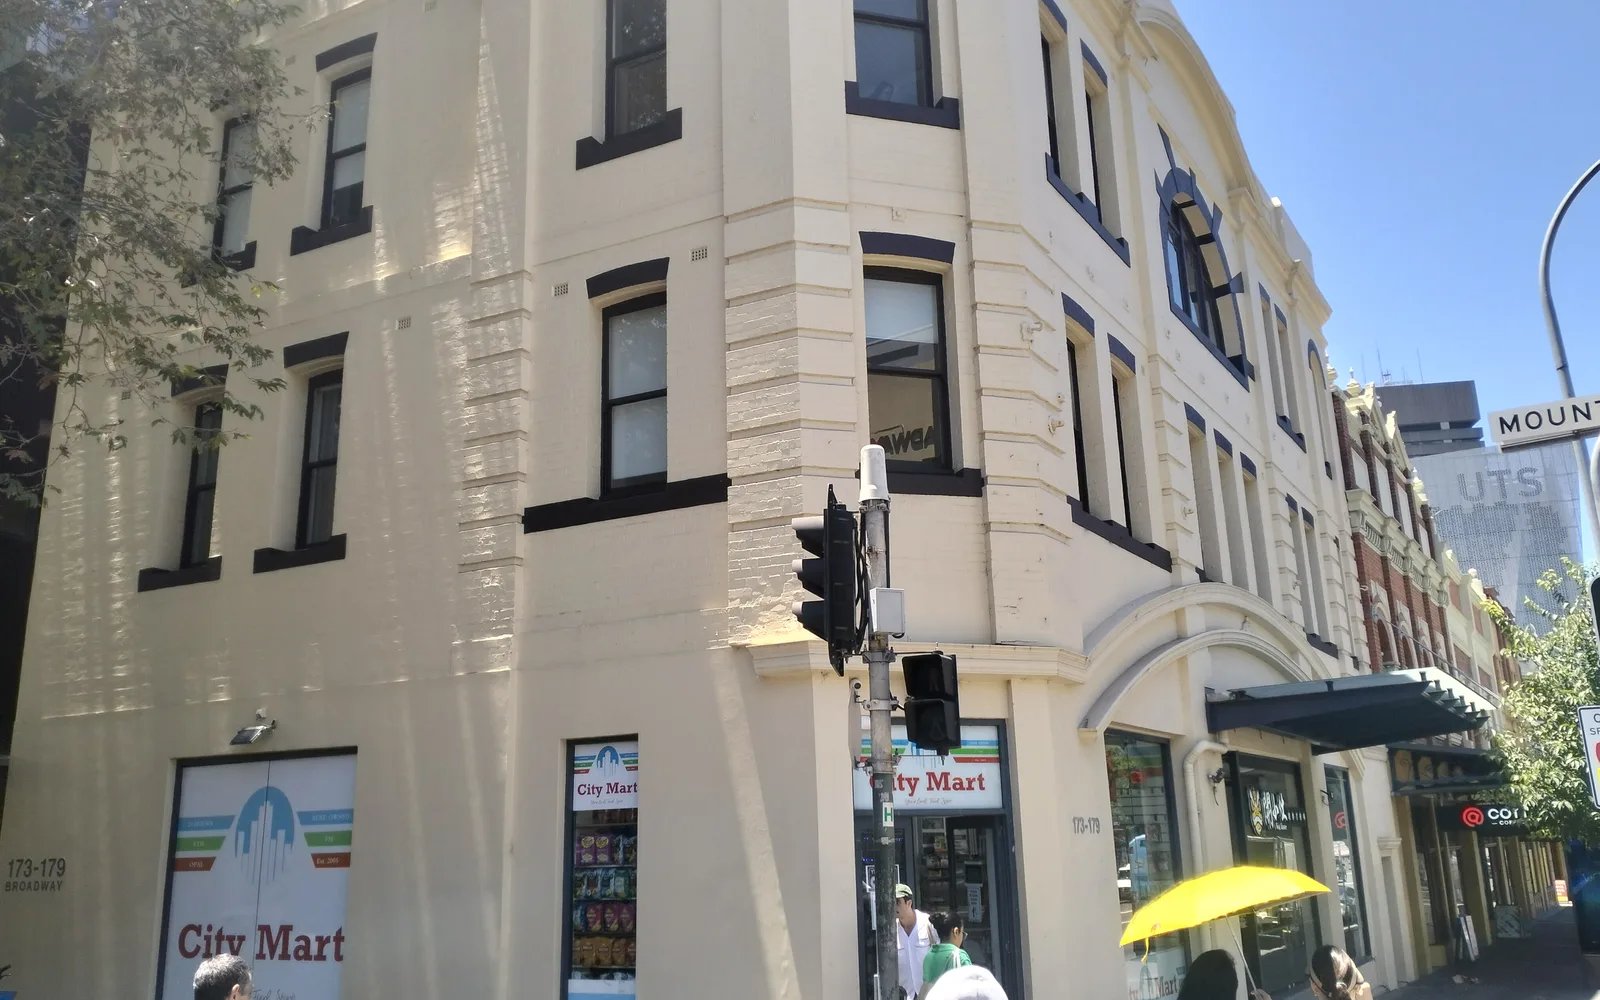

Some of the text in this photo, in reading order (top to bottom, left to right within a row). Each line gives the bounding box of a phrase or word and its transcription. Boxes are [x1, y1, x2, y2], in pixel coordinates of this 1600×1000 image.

[1499, 399, 1600, 435] MOUN
[1456, 466, 1544, 503] UTS
[577, 782, 638, 798] City Mart
[926, 772, 985, 791] Mart
[884, 807, 893, 822] H
[1072, 816, 1101, 835] 173-179
[8, 857, 66, 878] 173-179
[5, 880, 63, 892] BROADWAY
[255, 923, 345, 962] Mart
